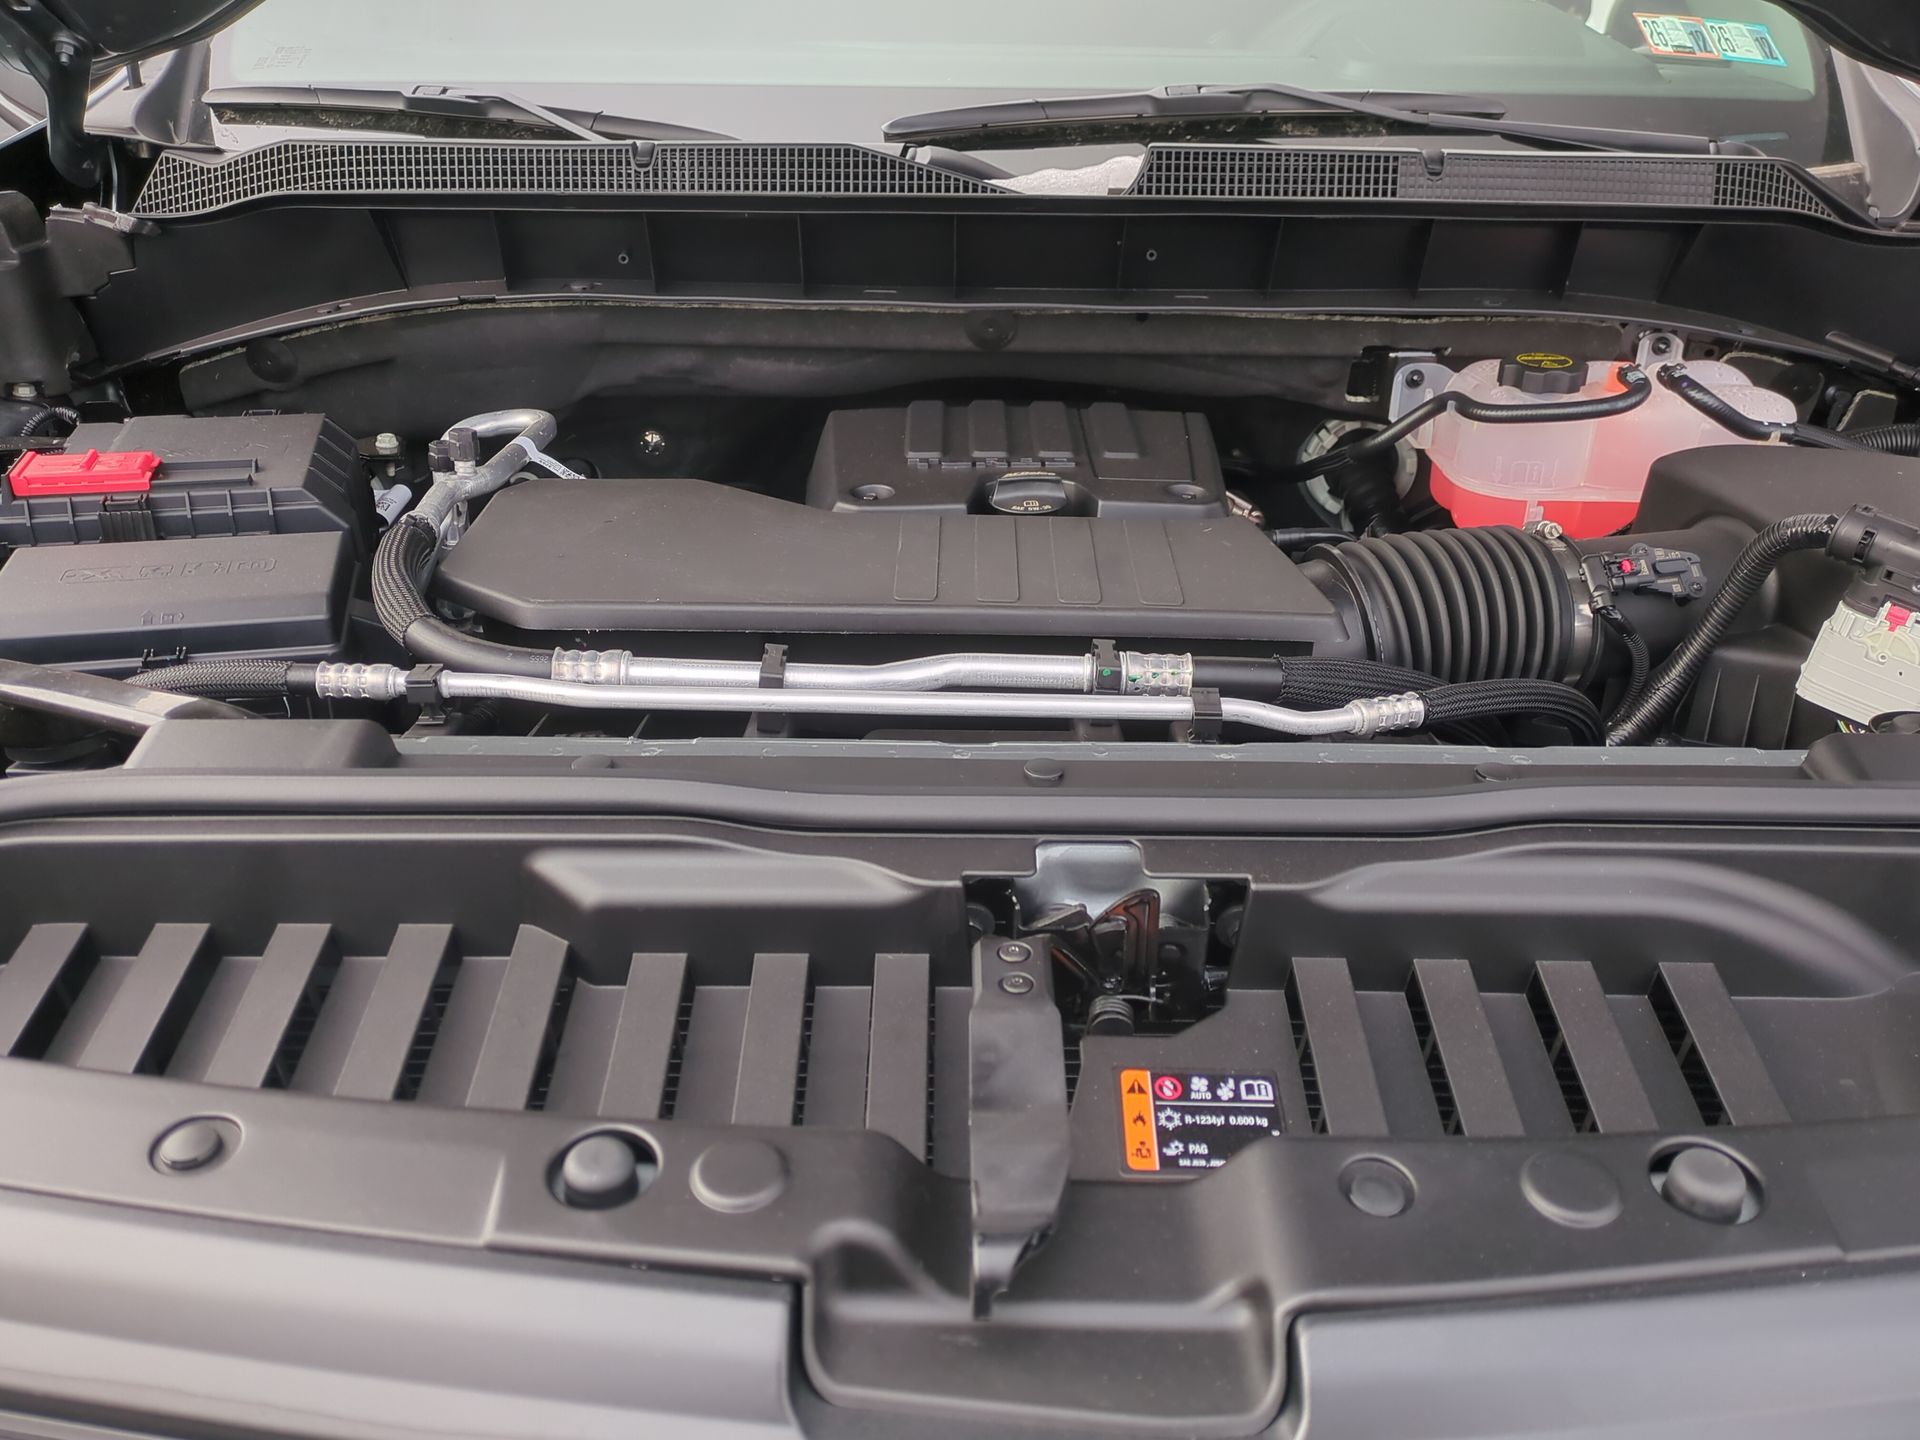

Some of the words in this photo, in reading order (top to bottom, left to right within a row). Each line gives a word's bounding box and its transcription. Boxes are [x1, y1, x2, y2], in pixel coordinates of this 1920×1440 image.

[1642, 20, 1669, 48] 26
[1710, 24, 1737, 53] 26
[1190, 1091, 1212, 1100] AUTO
[1184, 1115, 1225, 1126] R-1234yf
[1255, 1116, 1269, 1127] kg
[1188, 1142, 1209, 1155] PAG
